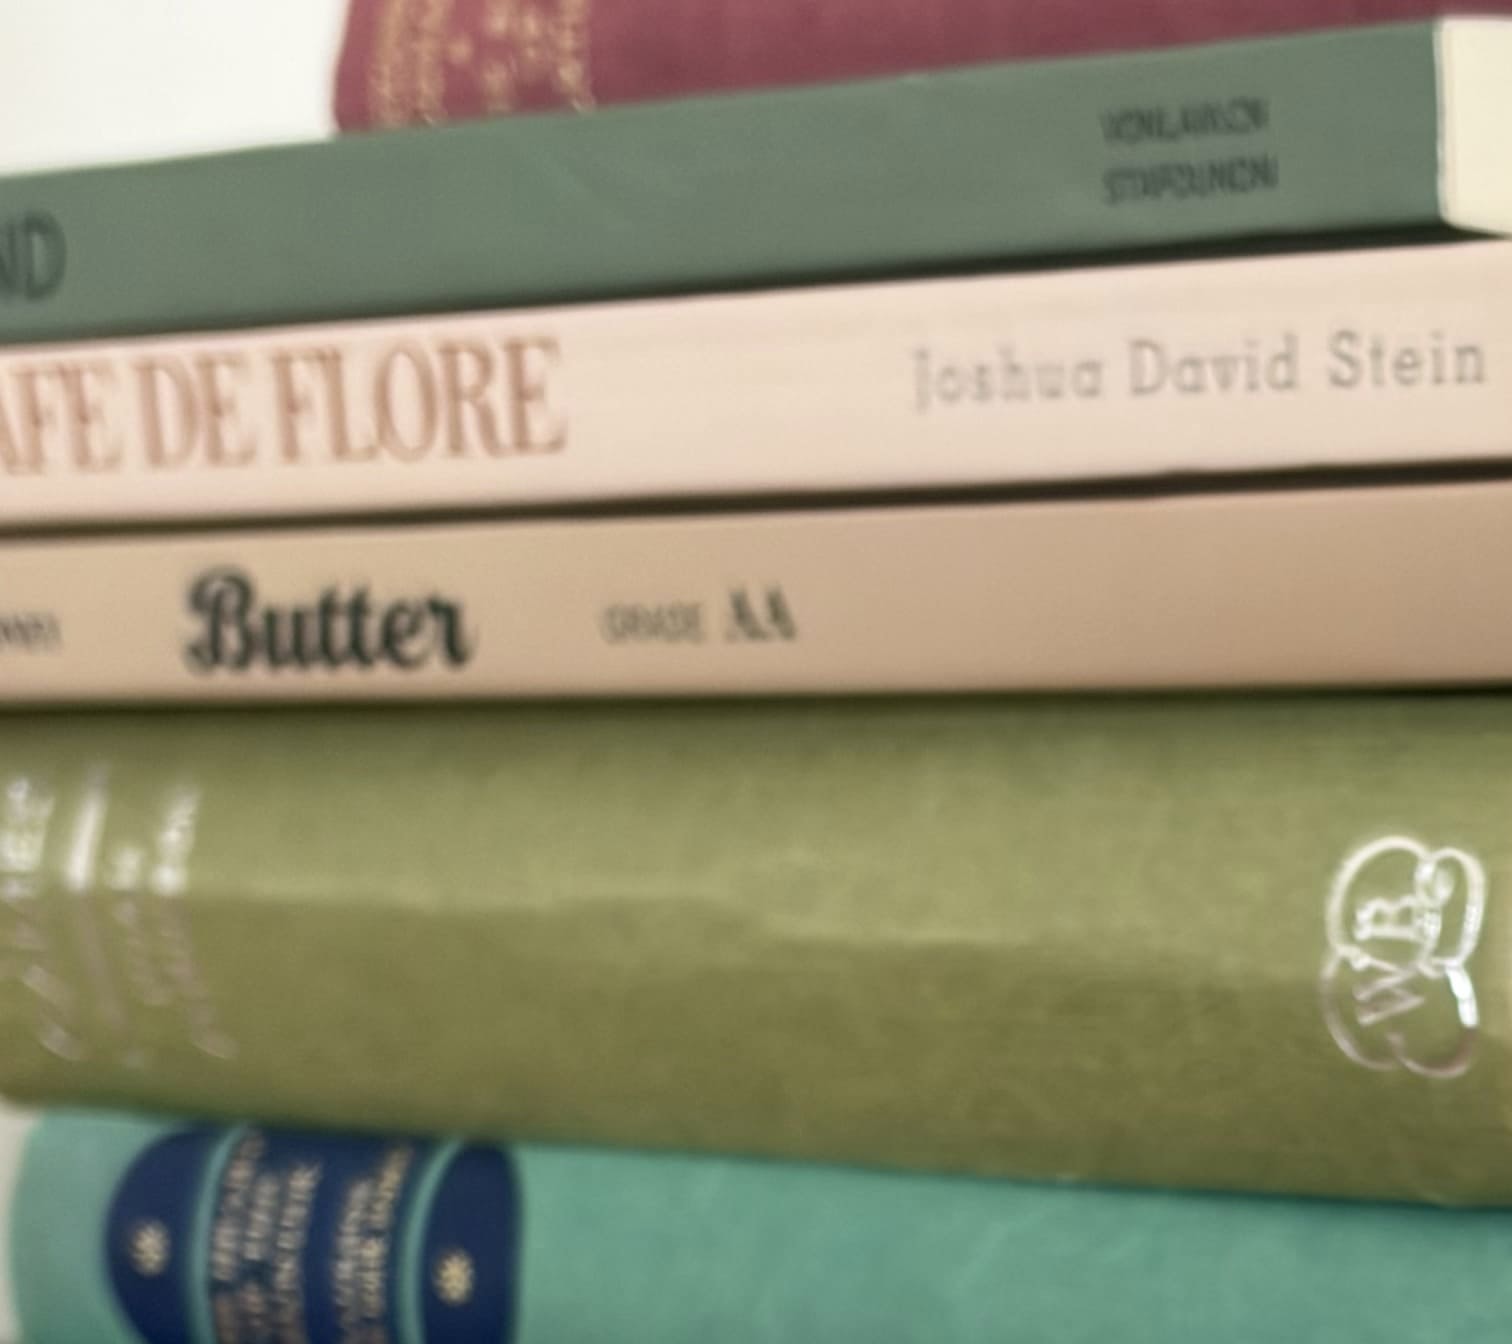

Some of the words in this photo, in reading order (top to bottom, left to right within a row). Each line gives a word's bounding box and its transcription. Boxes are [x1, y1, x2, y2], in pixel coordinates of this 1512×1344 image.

[133, 352, 257, 468] DE
[270, 337, 568, 464] FLORE
[911, 346, 1104, 413] Joshua
[1129, 334, 1299, 396] David
[1327, 329, 1487, 390] Stein
[185, 566, 474, 673] Butter
